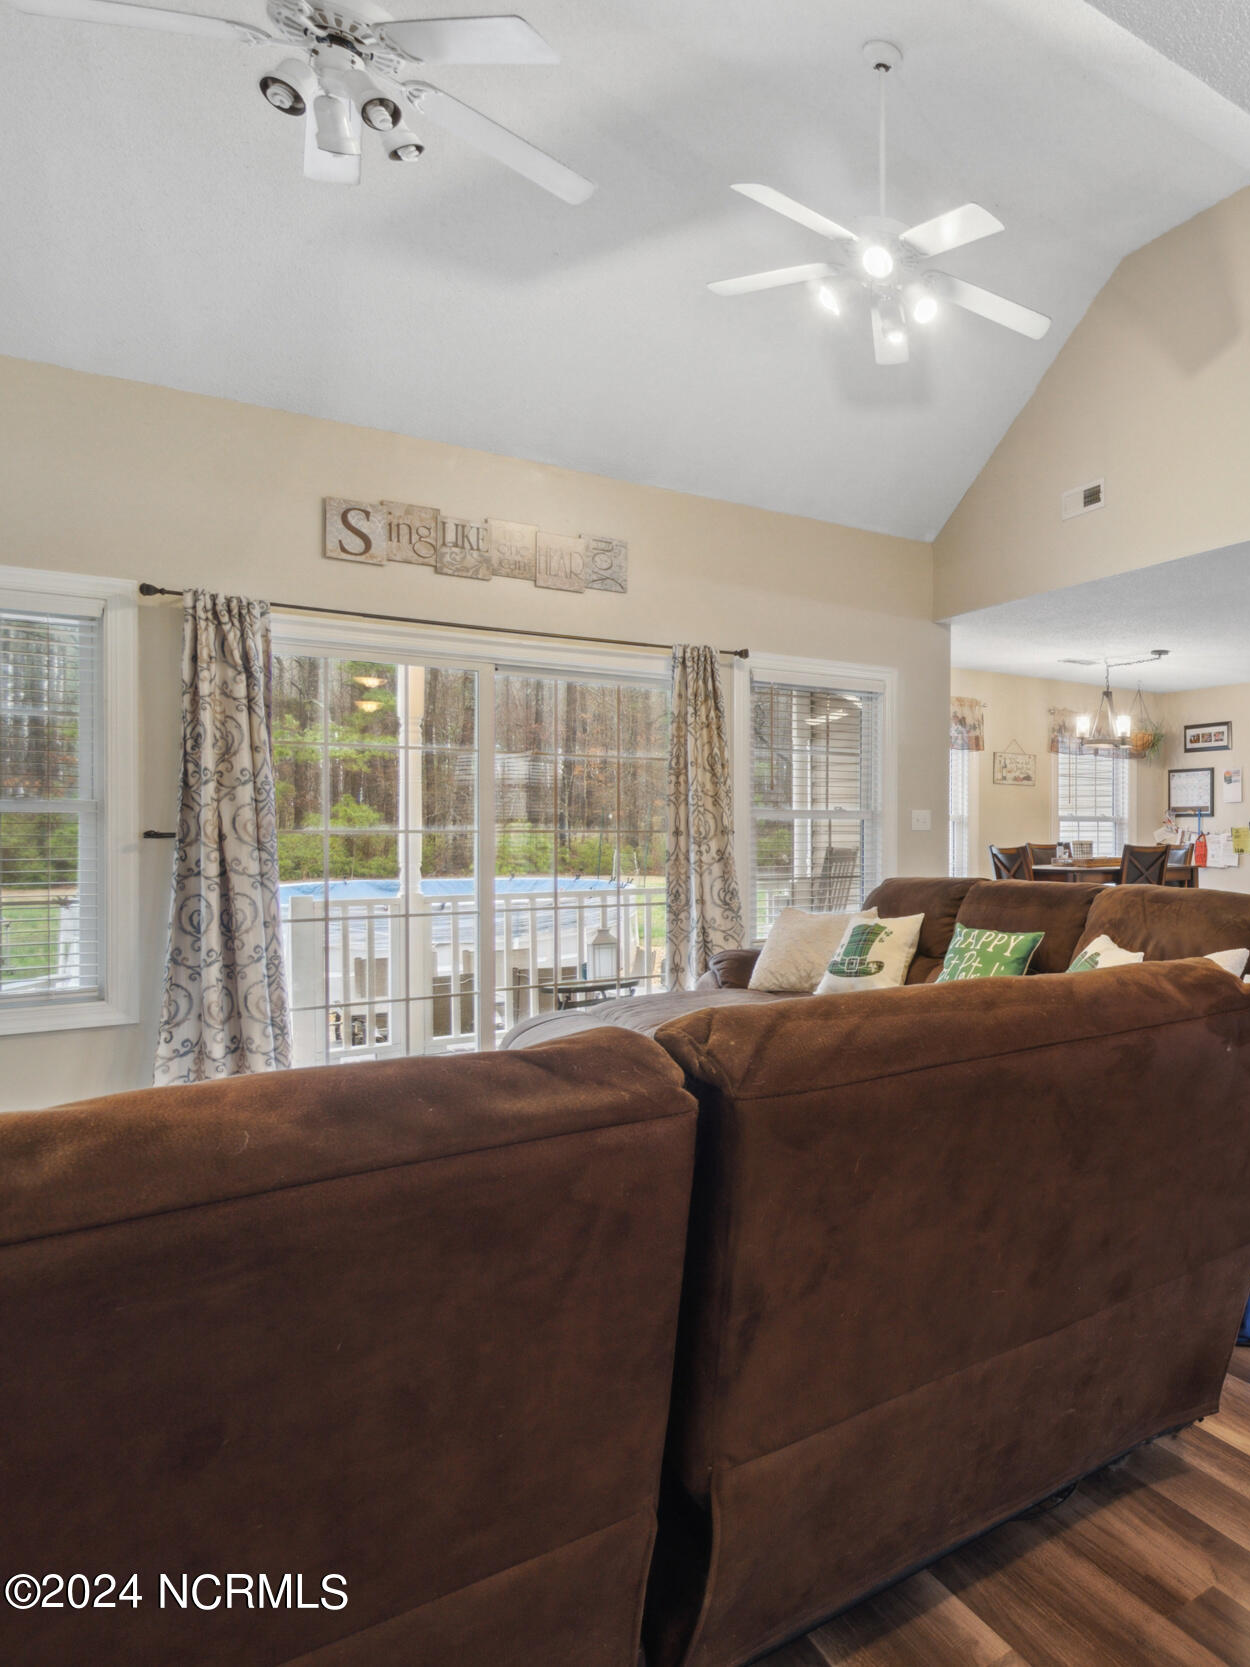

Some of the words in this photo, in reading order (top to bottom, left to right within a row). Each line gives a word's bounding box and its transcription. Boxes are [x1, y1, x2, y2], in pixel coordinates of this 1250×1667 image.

[339, 507, 436, 559] Sing
[440, 520, 489, 552] LIKE
[537, 544, 584, 581] HEAR
[591, 538, 624, 590] you
[950, 928, 1025, 957] HAPPY
